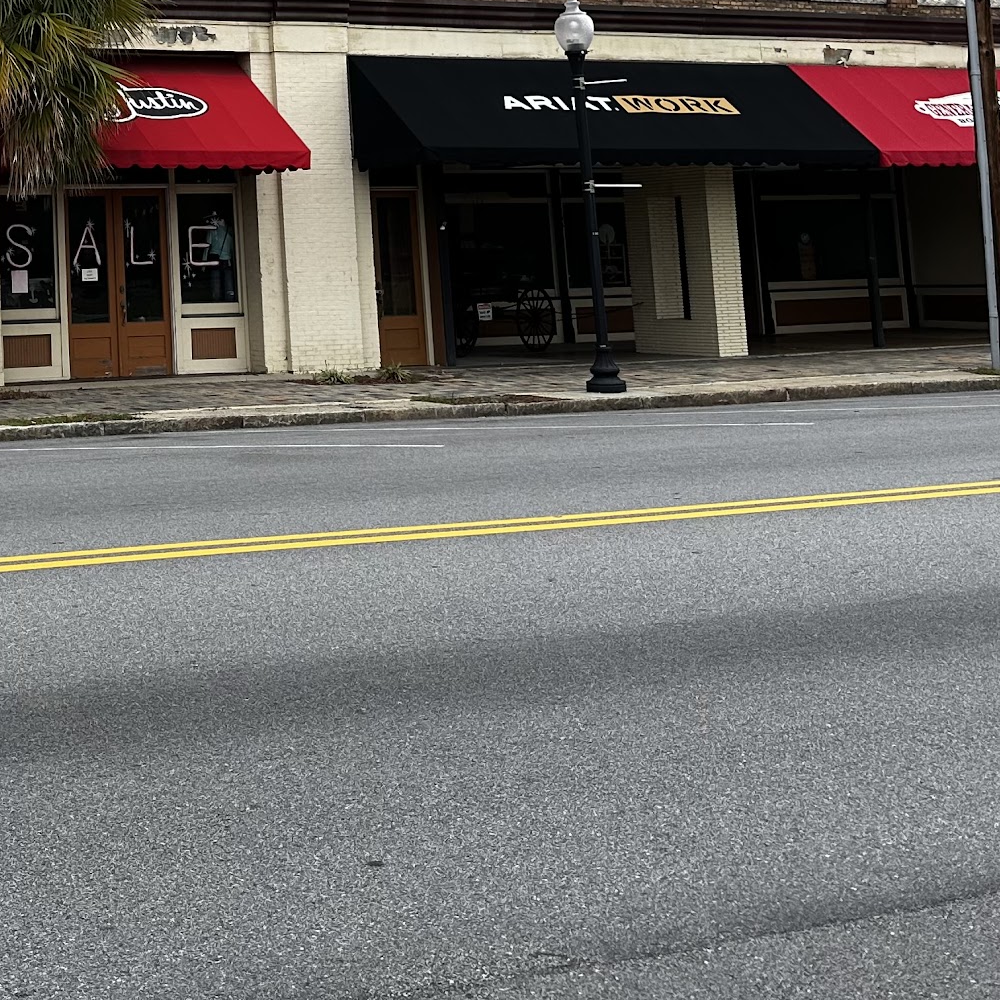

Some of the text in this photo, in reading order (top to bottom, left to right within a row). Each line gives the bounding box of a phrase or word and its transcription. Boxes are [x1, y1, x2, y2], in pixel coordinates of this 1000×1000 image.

[104, 81, 202, 123] Justin
[621, 97, 735, 113] WORK
[6, 223, 220, 268] SALE
